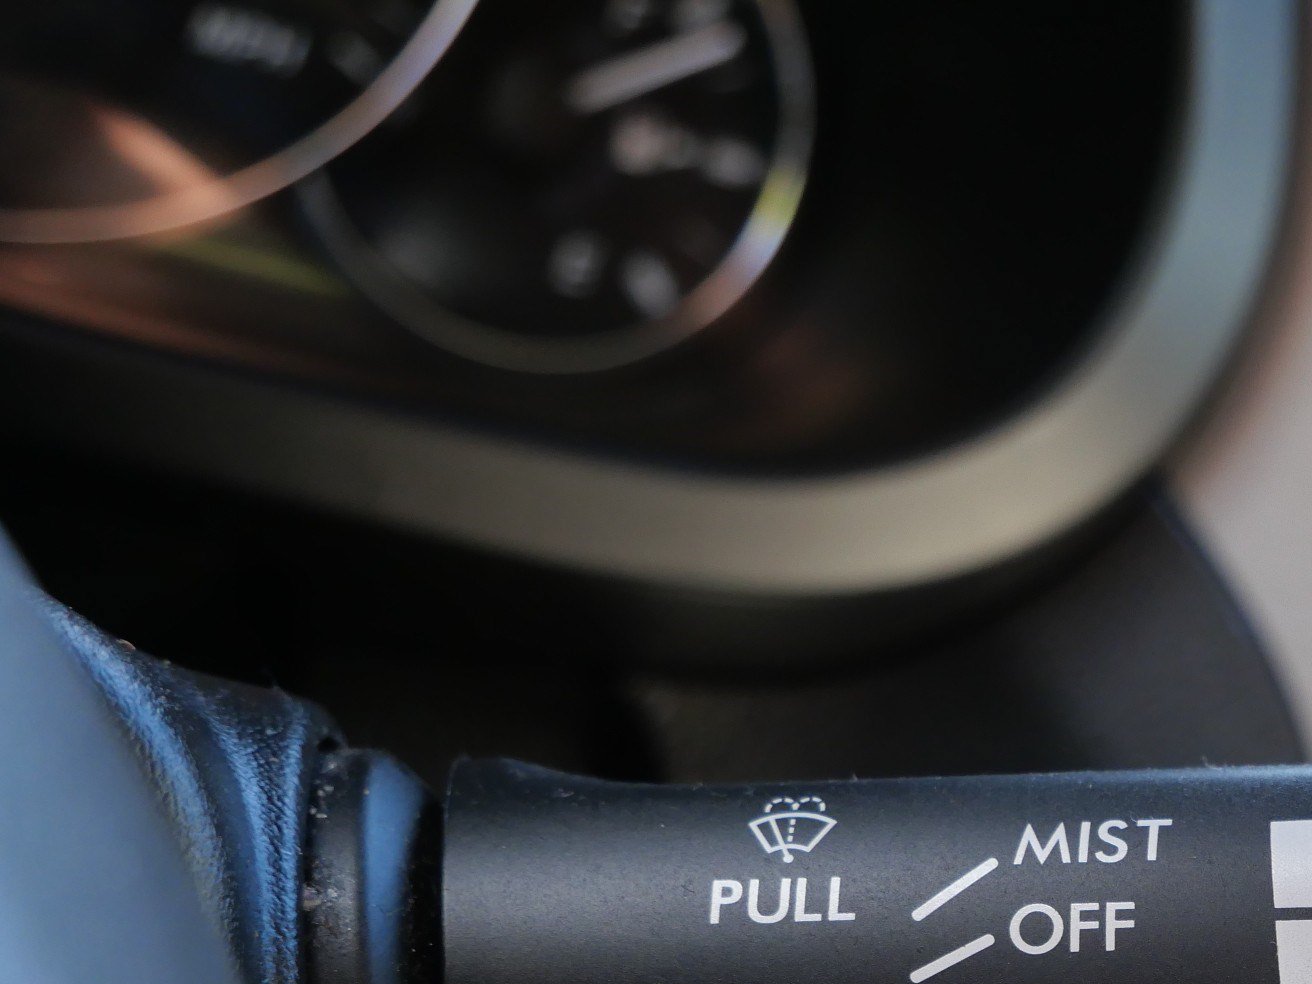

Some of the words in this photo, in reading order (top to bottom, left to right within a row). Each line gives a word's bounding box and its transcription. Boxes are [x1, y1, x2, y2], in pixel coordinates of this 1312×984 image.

[1012, 817, 1173, 866] MIST
[709, 876, 856, 924] PULL
[1008, 901, 1136, 955] OFF
